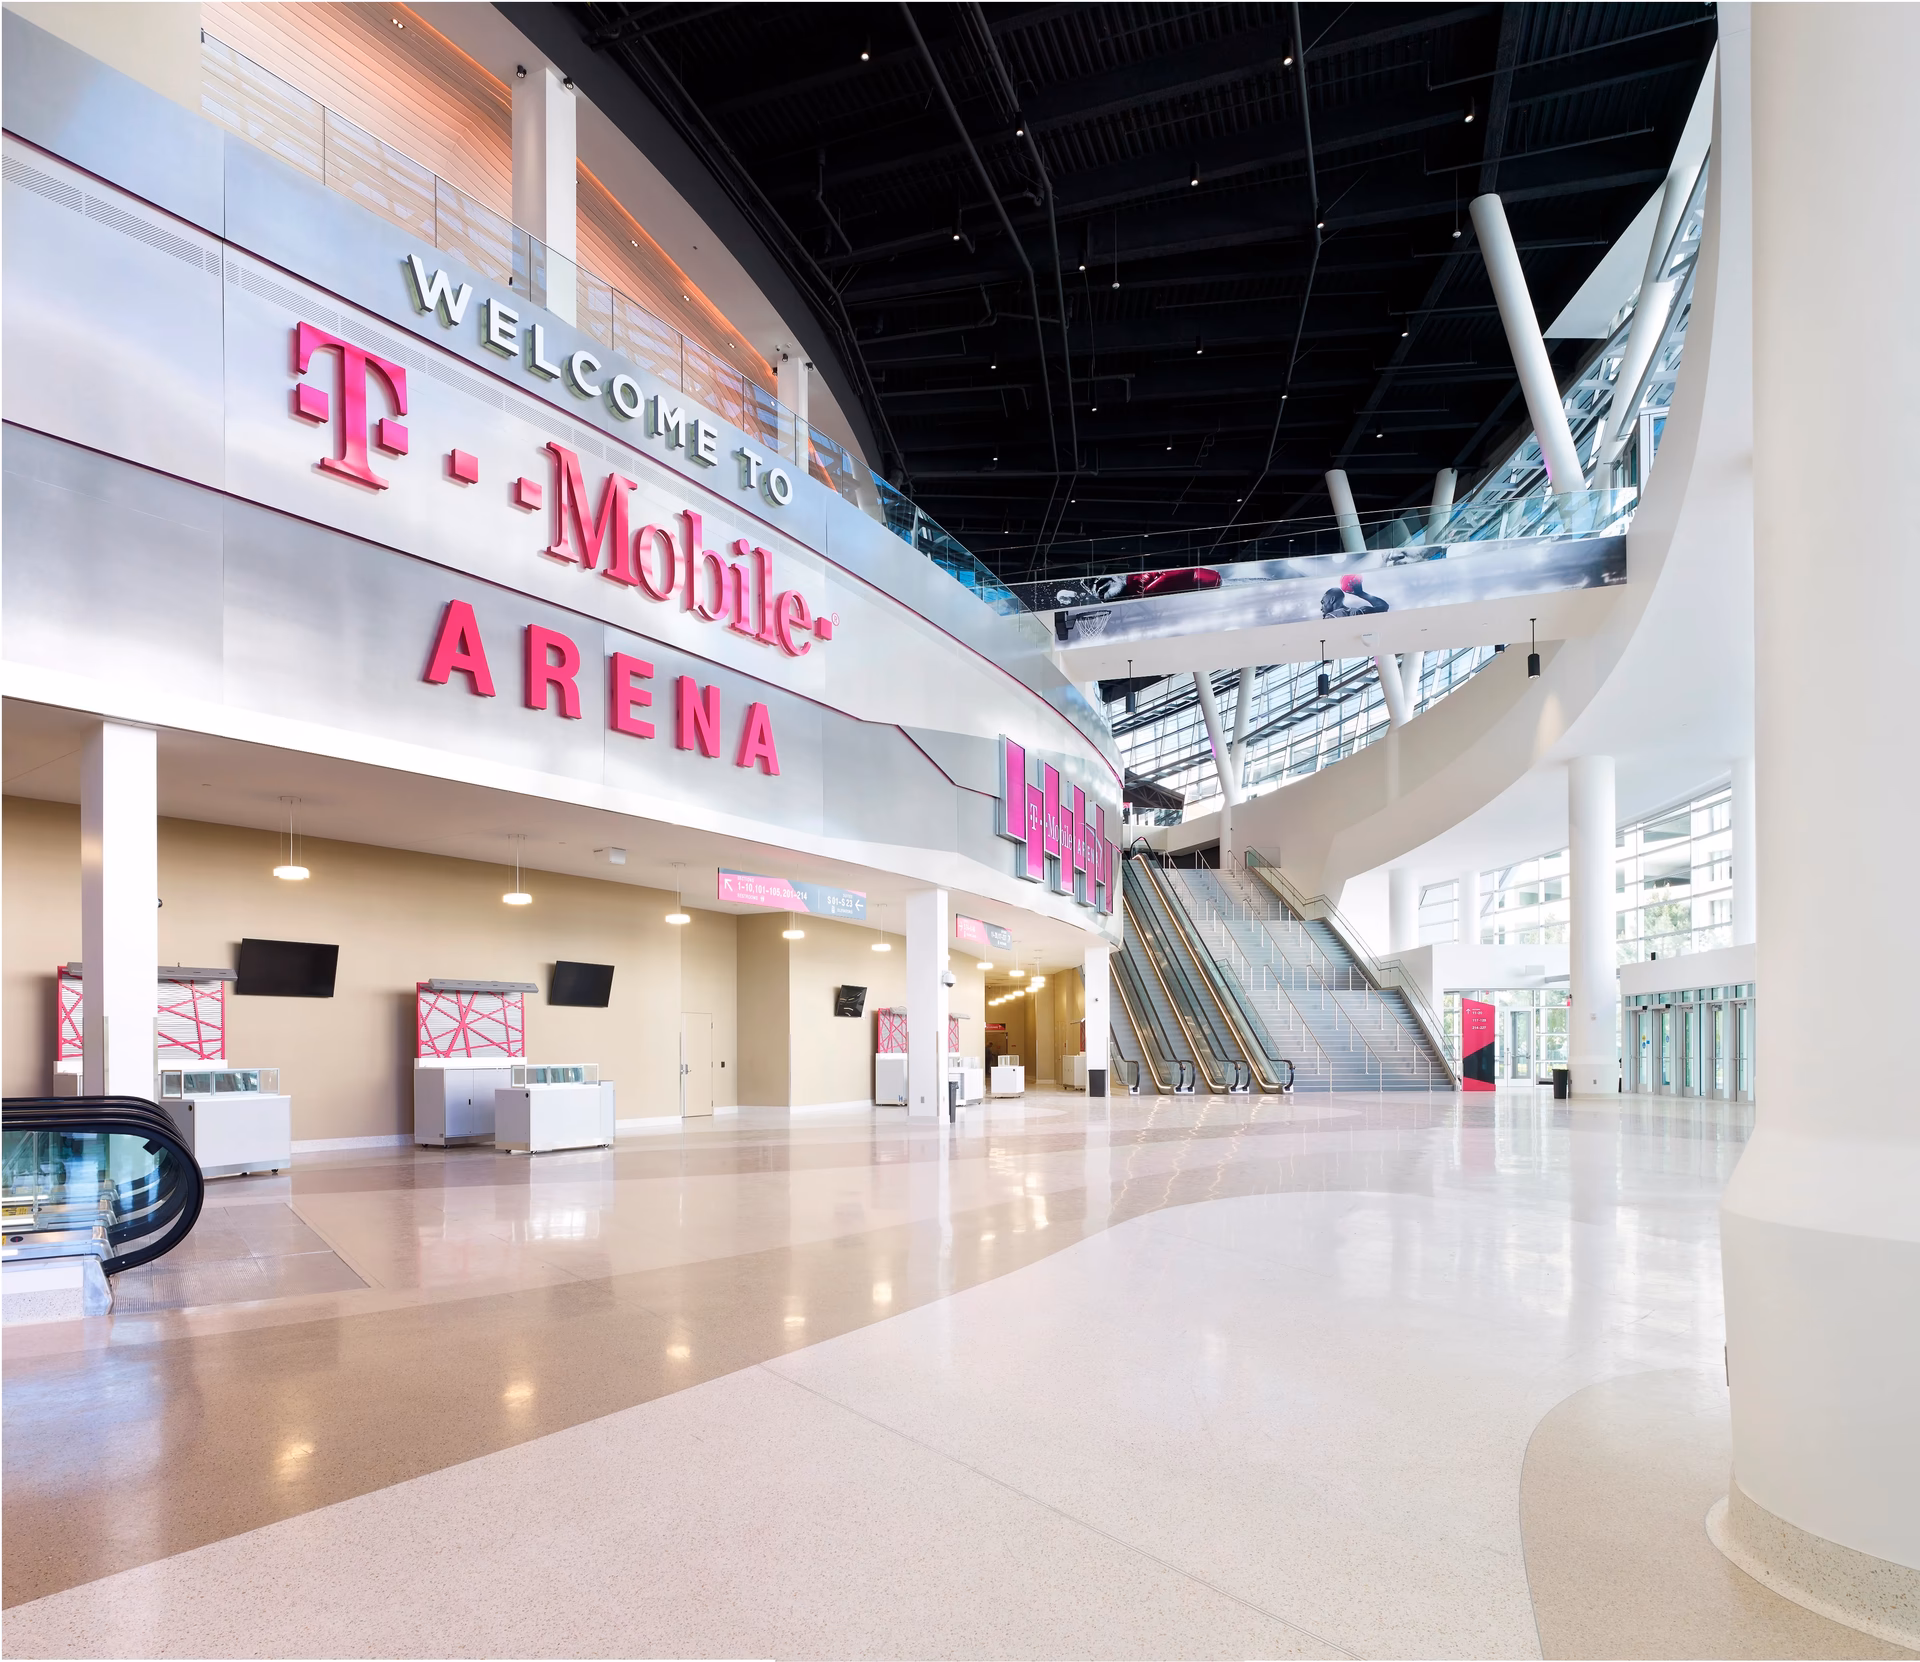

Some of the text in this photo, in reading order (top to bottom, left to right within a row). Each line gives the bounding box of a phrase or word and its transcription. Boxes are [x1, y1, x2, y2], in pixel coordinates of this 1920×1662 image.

[405, 254, 794, 506] WELCOME TO
[424, 599, 781, 776] ARENA
